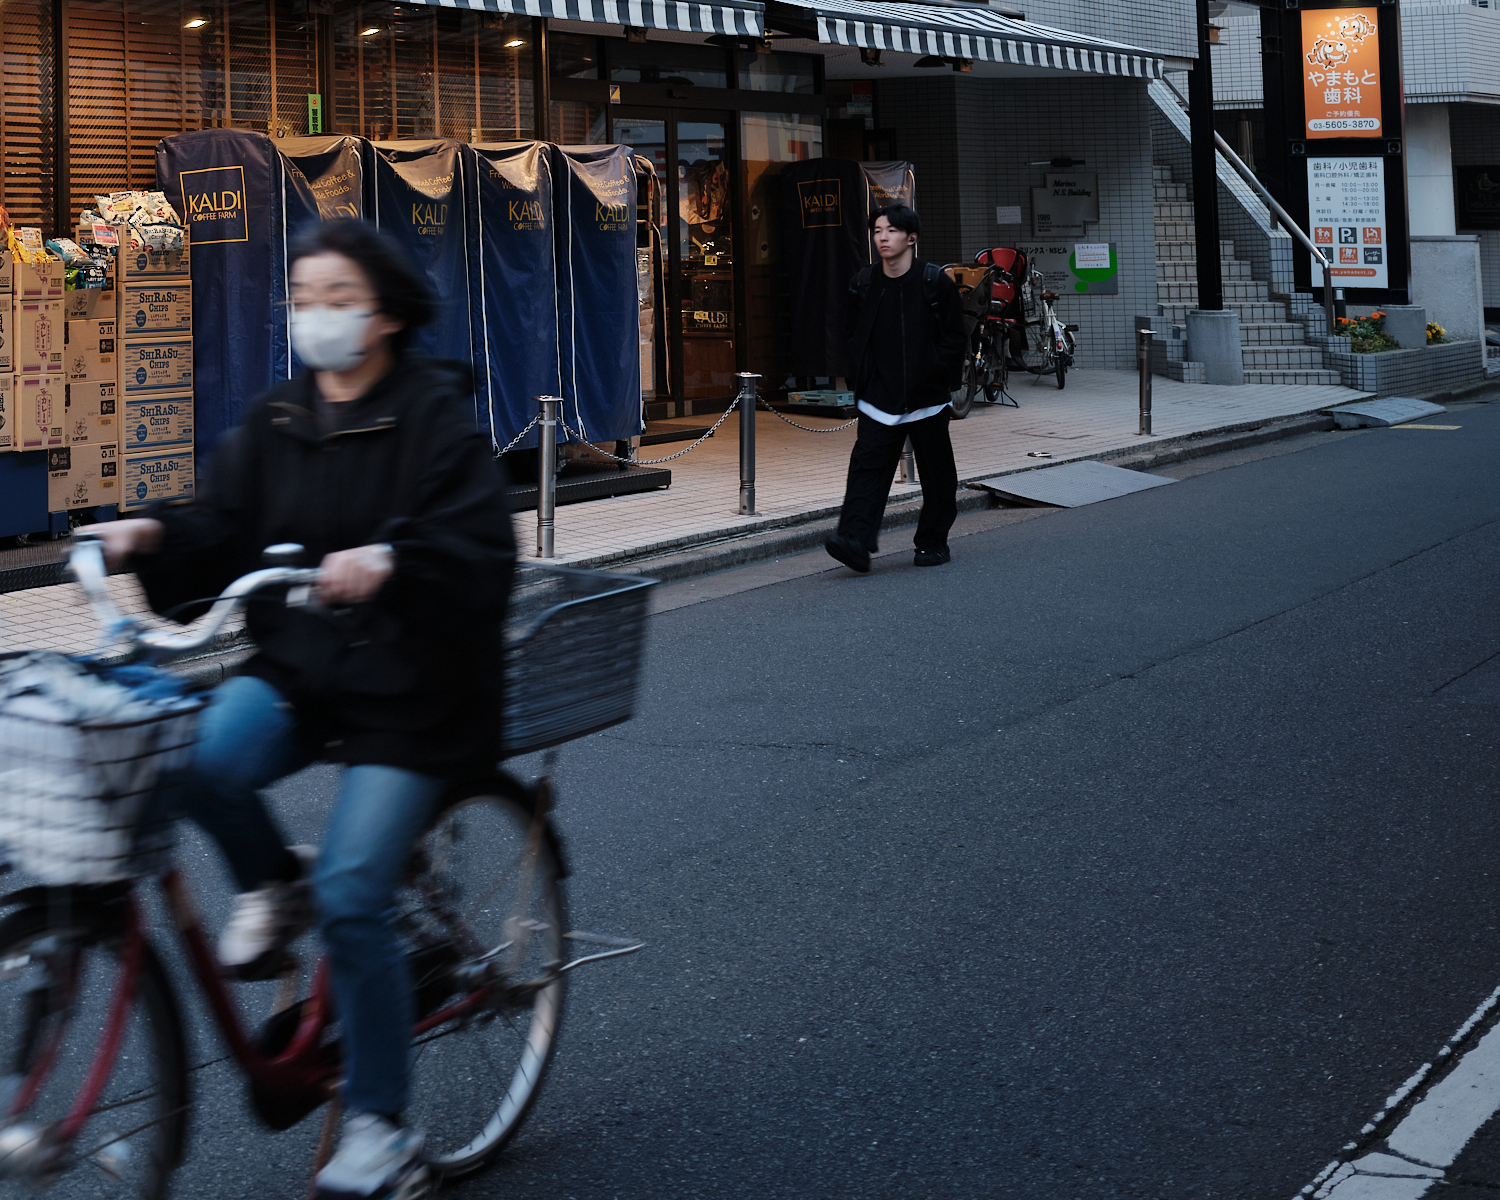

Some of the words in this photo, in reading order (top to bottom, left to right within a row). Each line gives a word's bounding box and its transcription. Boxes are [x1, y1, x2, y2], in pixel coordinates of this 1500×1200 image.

[1308, 69, 1377, 87] やまもと
[1323, 87, 1362, 104] 歯科
[1313, 120, 1375, 129] 03-5605-3870
[189, 190, 242, 213] KALDI
[803, 193, 838, 209] KALDI
[192, 212, 217, 222] COFFEE
[218, 211, 237, 220] FARM
[412, 203, 449, 225] KALD
[509, 200, 545, 221] KALDI
[595, 202, 630, 221] KALDI
[1037, 213, 1051, 221] 1989
